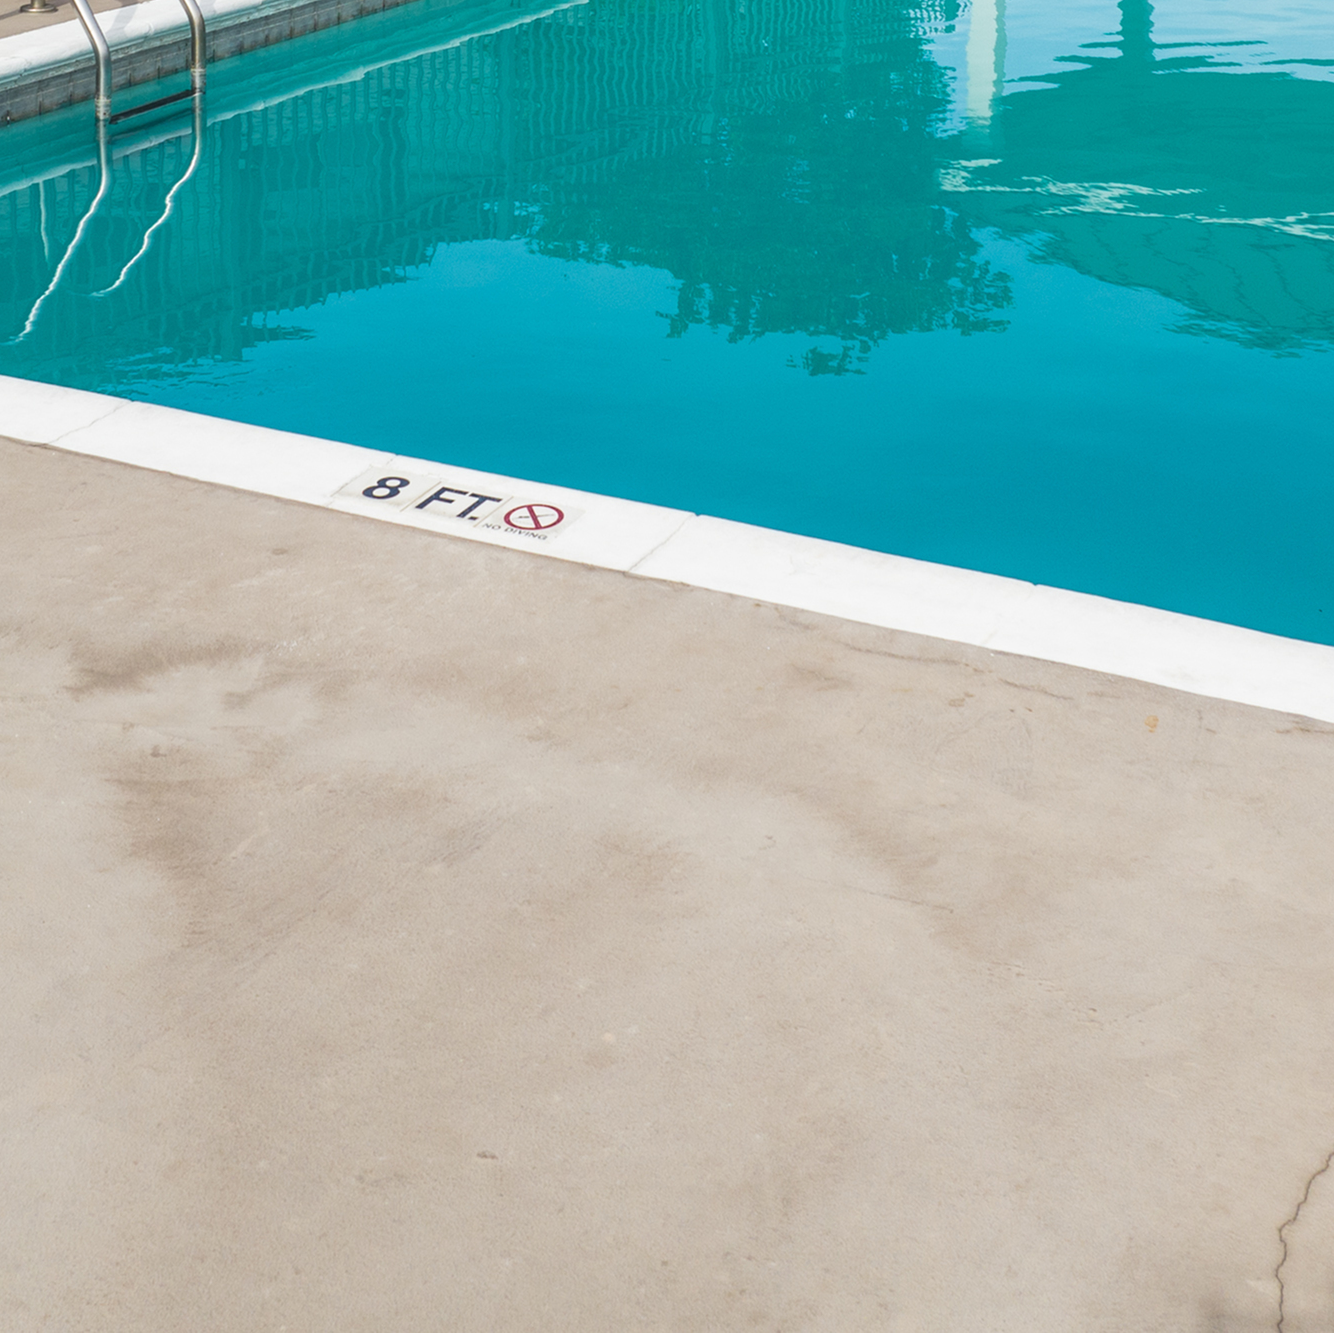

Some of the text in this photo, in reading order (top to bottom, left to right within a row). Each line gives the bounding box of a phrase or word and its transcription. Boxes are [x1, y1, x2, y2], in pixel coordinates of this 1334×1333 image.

[362, 476, 503, 521] 8 FT.
[504, 527, 548, 540] DIVING
